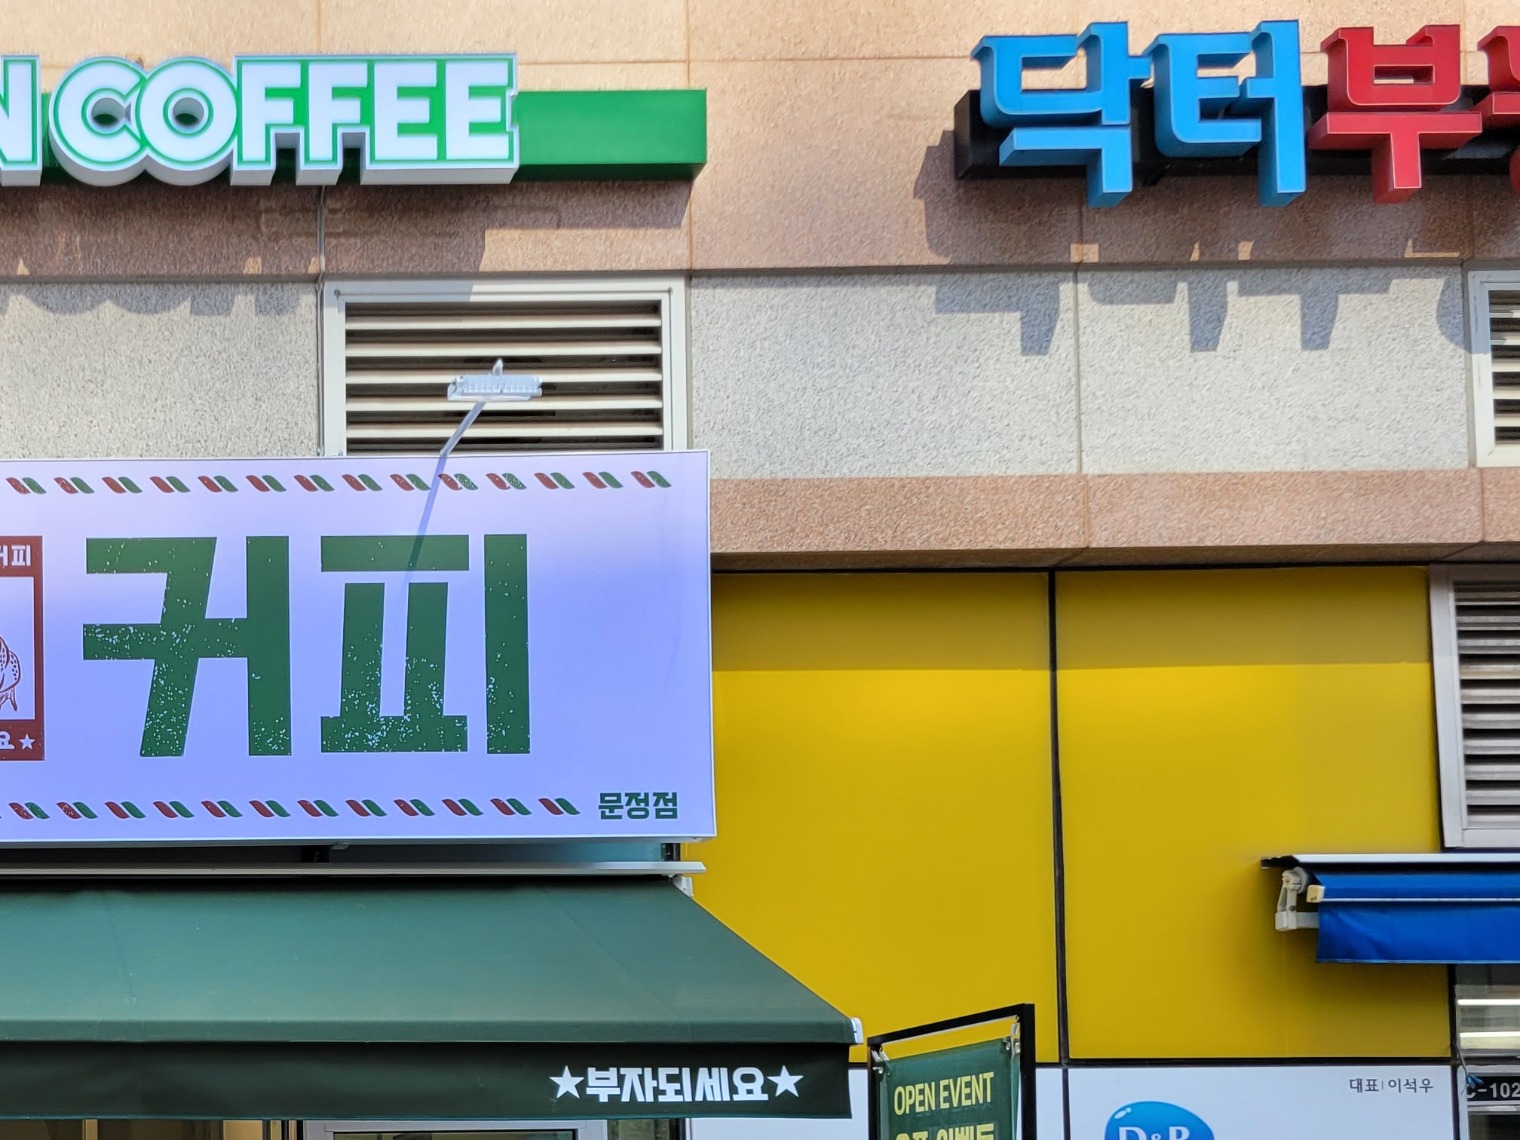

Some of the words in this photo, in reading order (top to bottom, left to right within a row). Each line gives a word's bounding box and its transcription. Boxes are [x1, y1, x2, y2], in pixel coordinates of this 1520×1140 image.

[49, 53, 518, 178] COFFEE
[971, 20, 1520, 206] 닥터부
[82, 533, 531, 757] 커피
[598, 791, 679, 820] 문정점
[586, 1066, 769, 1103] 부자되세요
[894, 1082, 935, 1115] OPEN
[940, 1072, 994, 1109] EVENT
[1349, 1078, 1379, 1093] 대표
[1387, 1078, 1434, 1093] 이석우
